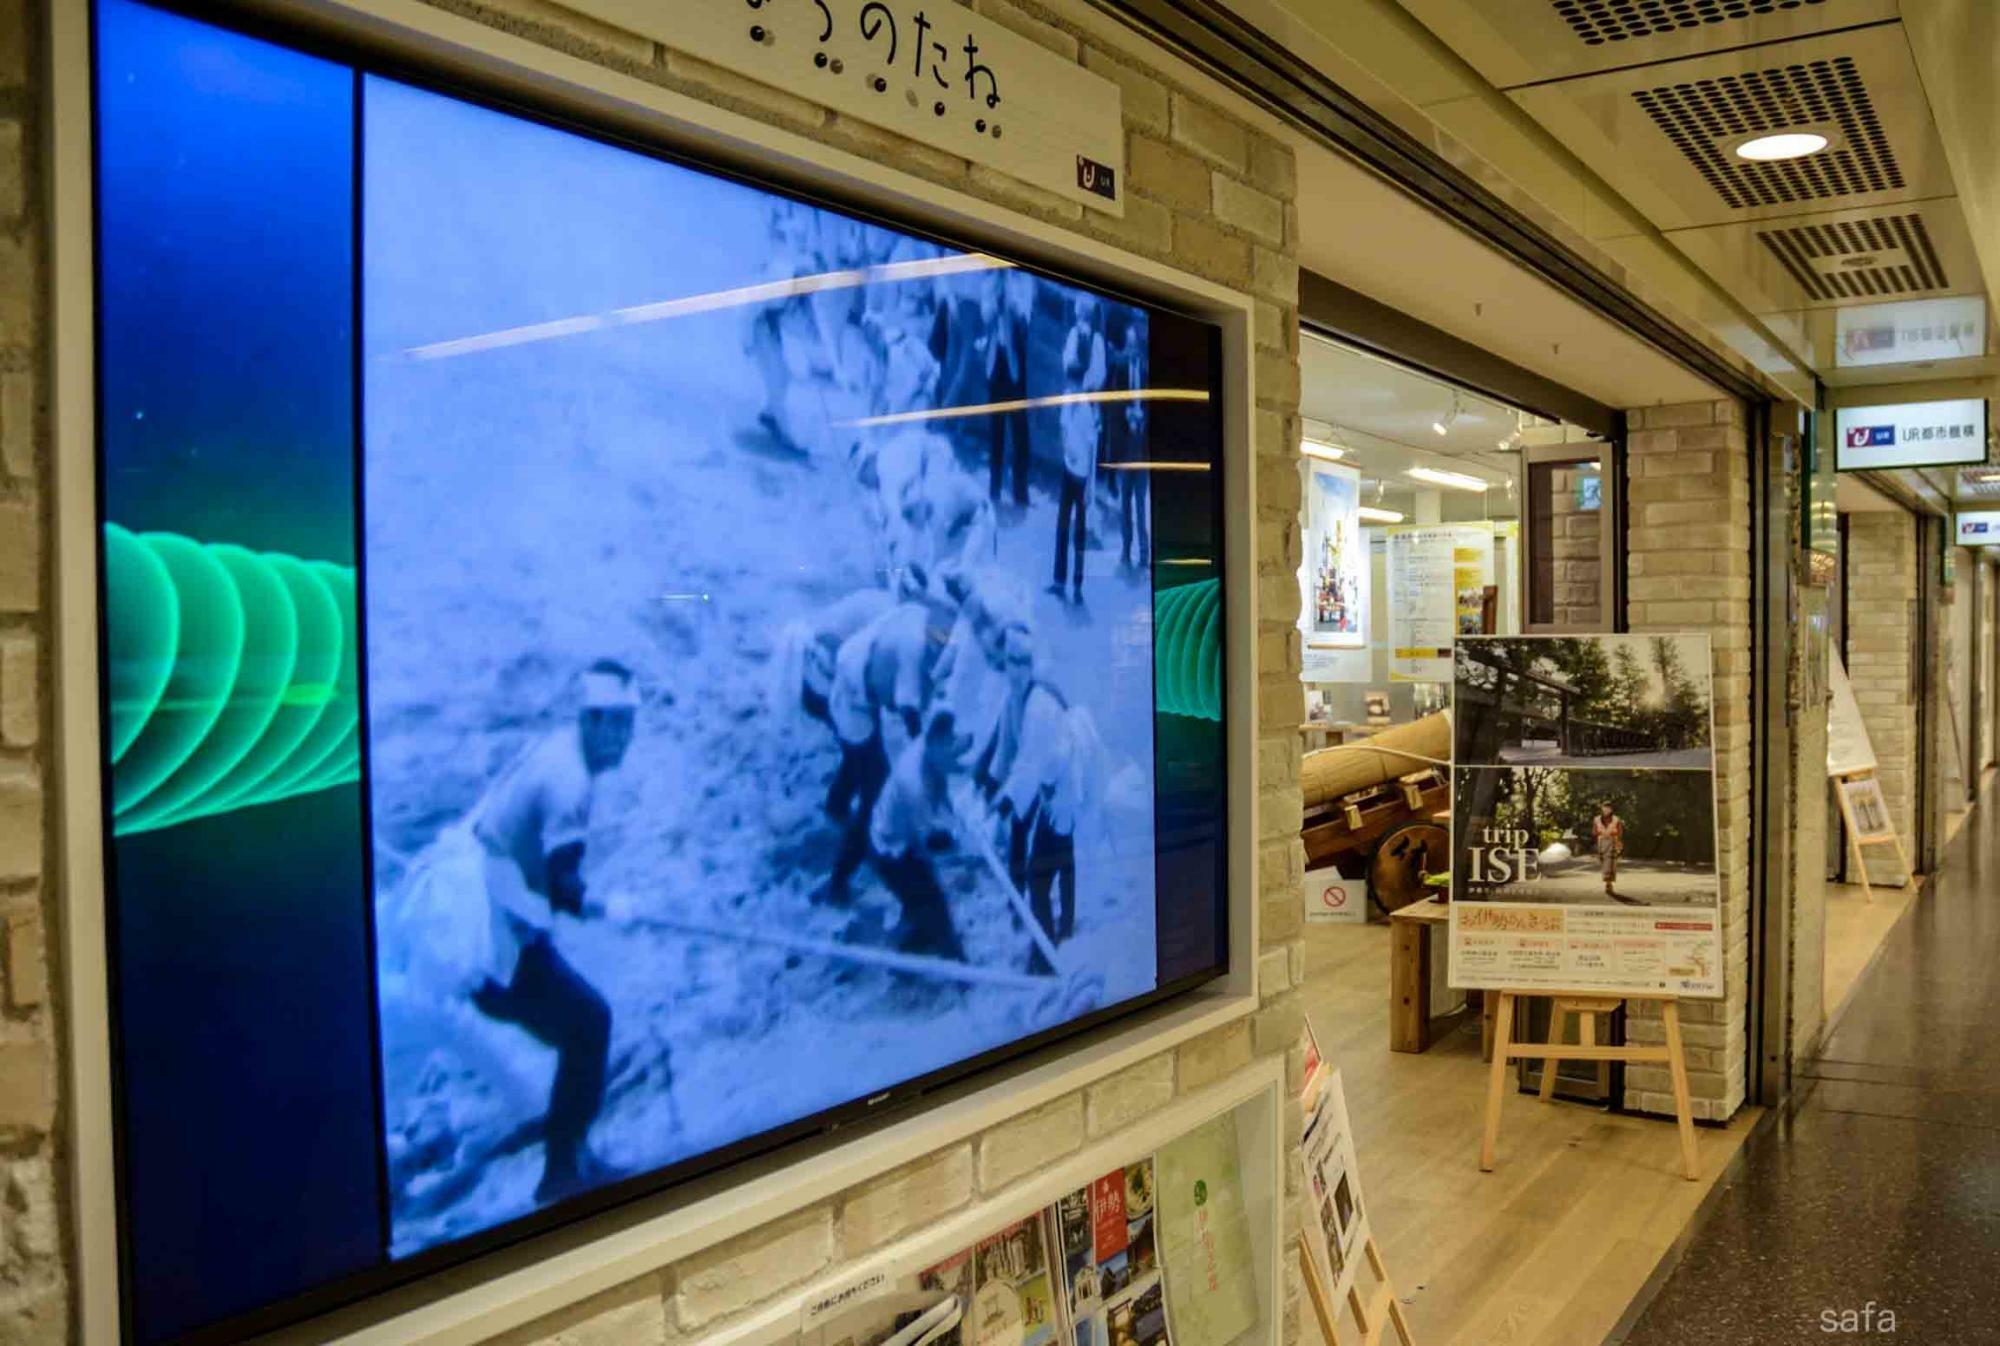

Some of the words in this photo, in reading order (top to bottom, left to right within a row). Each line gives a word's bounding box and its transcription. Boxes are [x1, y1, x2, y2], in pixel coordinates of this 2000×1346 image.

[747, 0, 1000, 109] のたね
[1483, 823, 1529, 850] trip
[1467, 846, 1541, 883] ISE
